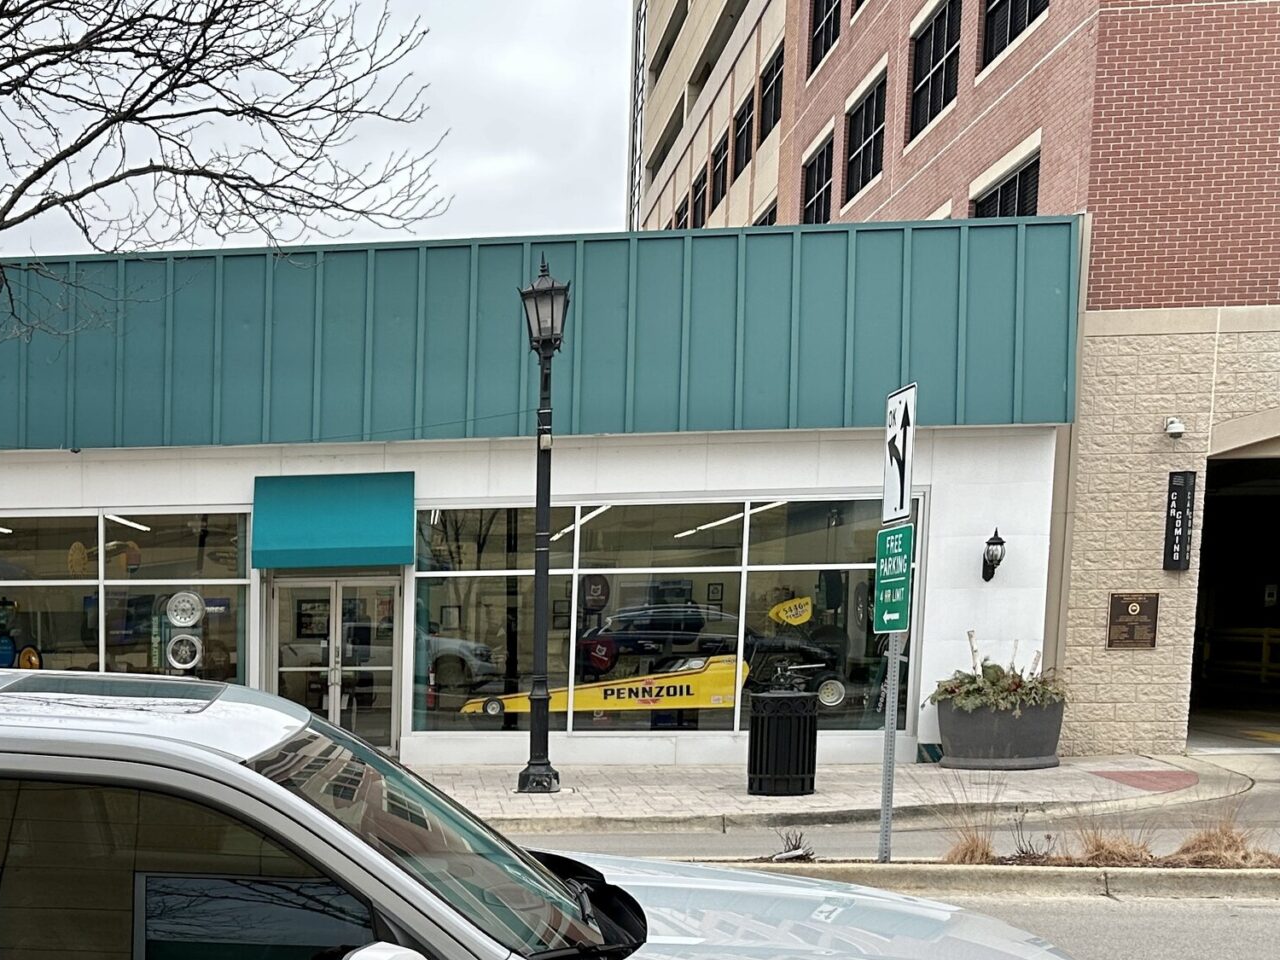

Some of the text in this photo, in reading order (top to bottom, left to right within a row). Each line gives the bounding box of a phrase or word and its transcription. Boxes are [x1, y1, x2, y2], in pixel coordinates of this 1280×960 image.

[889, 408, 897, 428] OK
[1170, 491, 1178, 517] CAR
[886, 534, 903, 555] FREE
[1173, 511, 1182, 561] COMING
[880, 555, 908, 576] PARKING
[884, 589, 892, 603] HR
[603, 684, 695, 700] PENNZOIL
